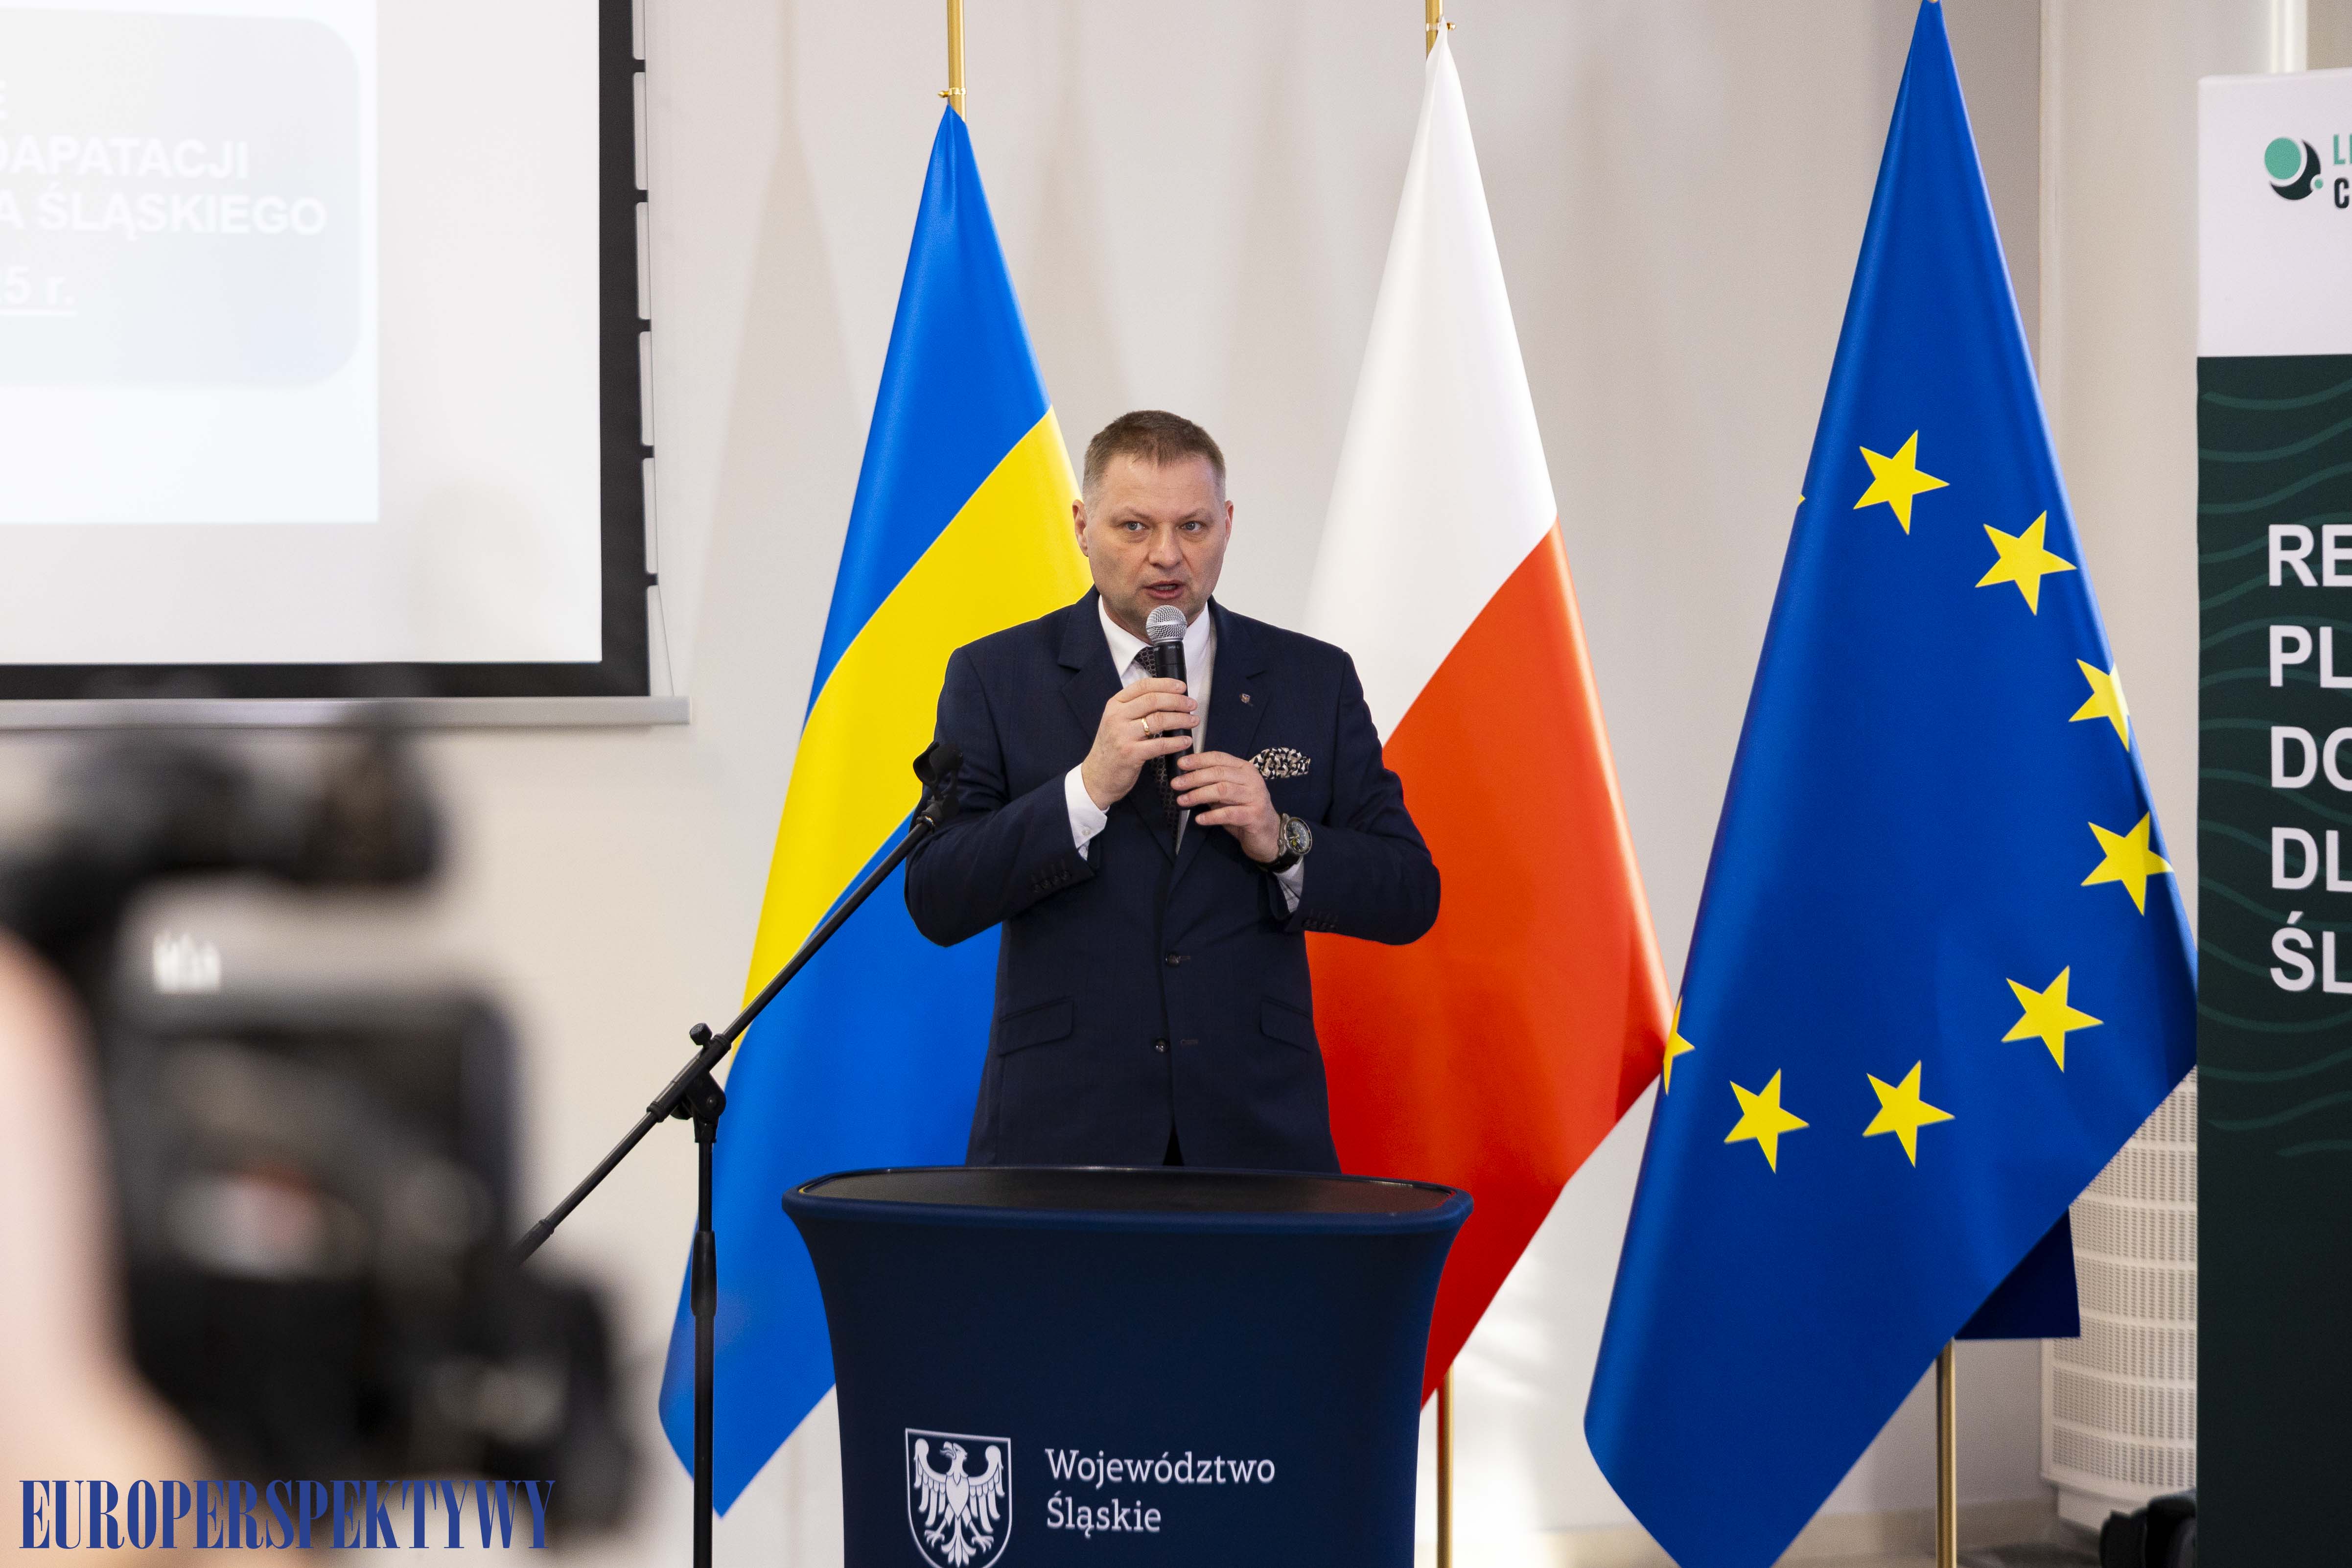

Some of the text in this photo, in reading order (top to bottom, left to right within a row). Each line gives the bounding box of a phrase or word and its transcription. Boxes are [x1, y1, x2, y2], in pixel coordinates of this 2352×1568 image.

[0, 135, 250, 179] APATACJI
[37, 181, 328, 241] ŚLĄSKIEGO
[46, 276, 75, 305] r.
[2268, 524, 2352, 587] RE
[2269, 625, 2352, 688] PL
[2271, 827, 2352, 892] DL
[2270, 911, 2352, 994] ŚL
[1045, 1448, 1275, 1490] Województwo
[1047, 1490, 1162, 1539] Śląskie
